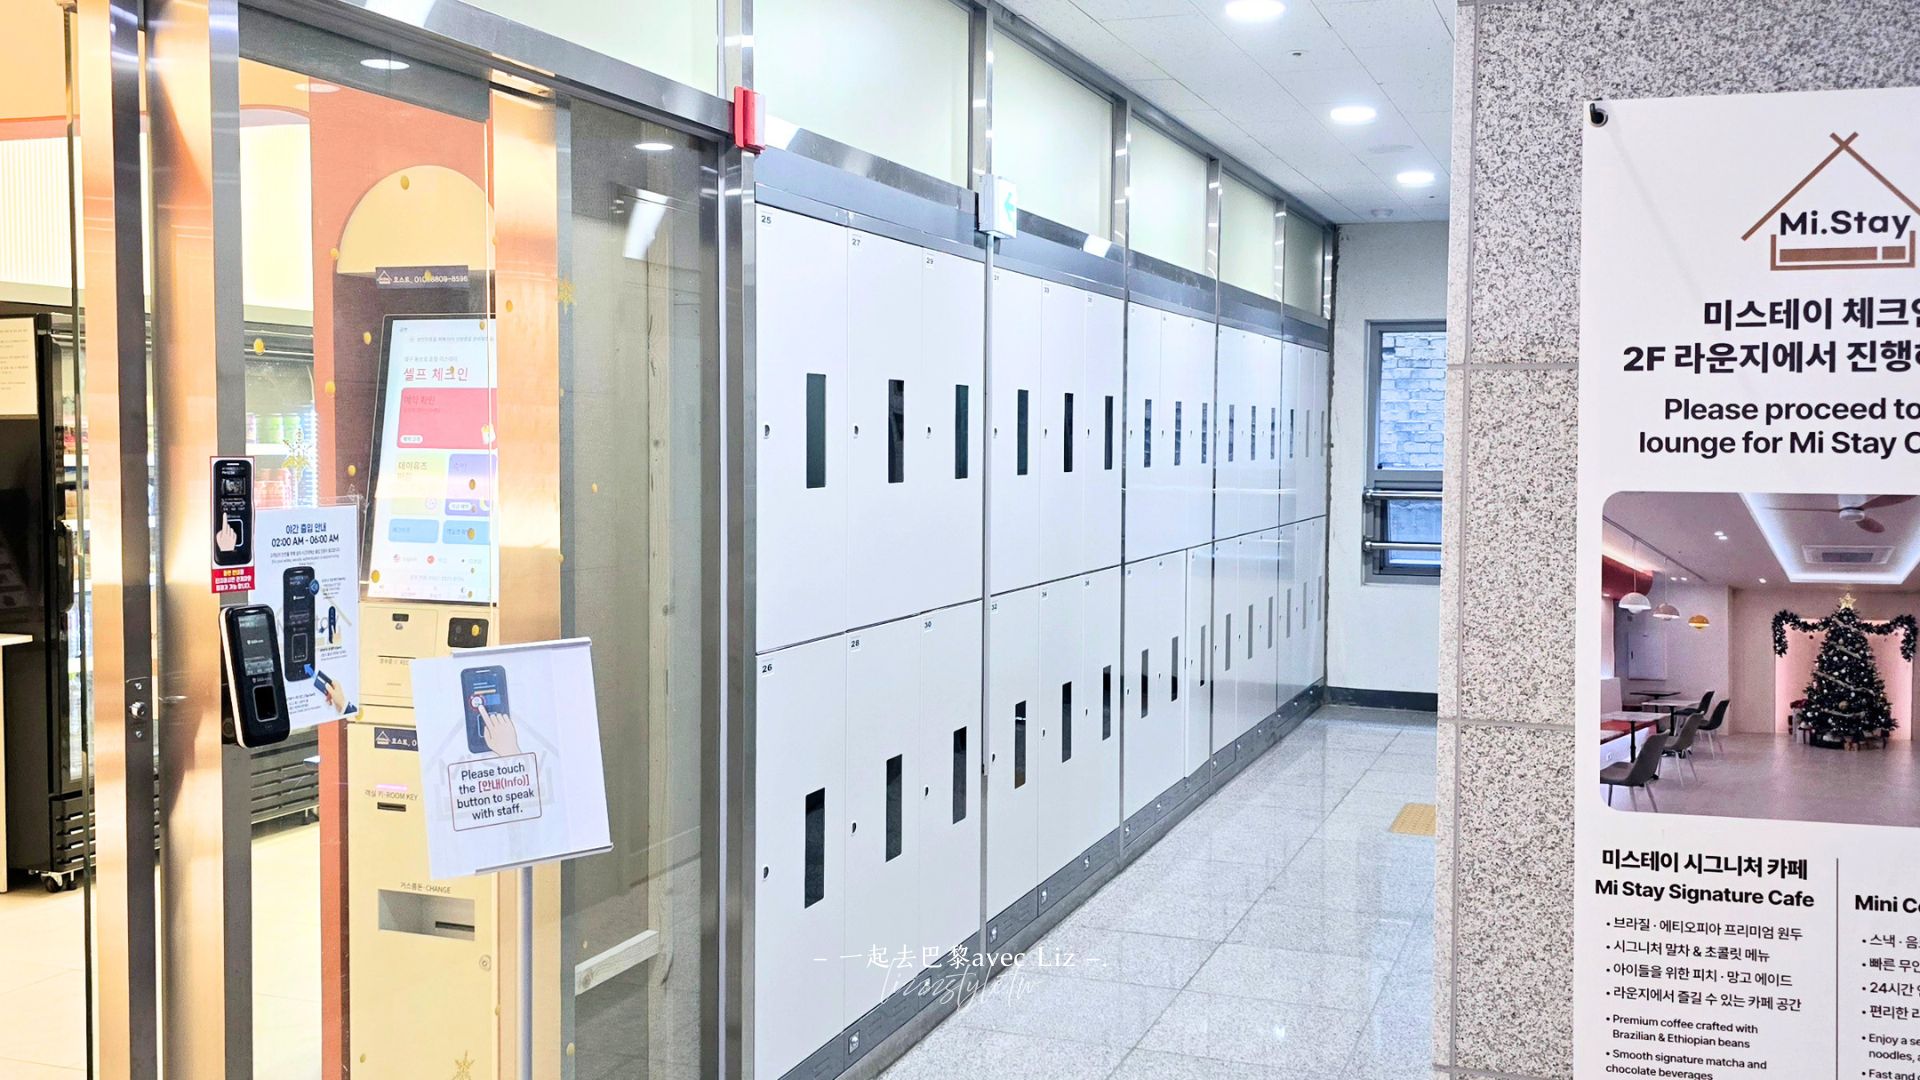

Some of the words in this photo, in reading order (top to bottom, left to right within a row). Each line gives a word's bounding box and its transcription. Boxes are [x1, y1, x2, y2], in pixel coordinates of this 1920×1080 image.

[761, 215, 772, 225] 25
[1780, 210, 1911, 239] Mi.Stay
[1704, 298, 1832, 331] 미스테이
[1623, 346, 1666, 371] 2F
[1674, 341, 1836, 374] 라운지에서
[1847, 340, 1920, 373] 진행
[1665, 398, 1758, 420] Please
[1766, 398, 1886, 425] proceed
[1894, 400, 1920, 420] to
[1640, 431, 1736, 459] lounge
[1742, 431, 1783, 453] for
[1790, 431, 1823, 453] Mi
[1831, 431, 1897, 459] Stay
[271, 537, 292, 547] 02:00
[292, 536, 304, 545] AM
[328, 534, 339, 543] AM
[851, 640, 860, 648] 28
[762, 664, 773, 673] 26
[461, 768, 495, 780] Please
[497, 762, 525, 775] touch
[458, 784, 476, 795] the
[478, 774, 530, 793] [안내(Info)]
[456, 796, 490, 809] button
[492, 794, 503, 803] to
[505, 788, 535, 803] speak
[472, 808, 494, 820] with
[497, 803, 523, 816] staff.
[1602, 849, 1679, 872] 미스테이
[1684, 853, 1762, 878] 시그니처
[1767, 858, 1808, 880] 카페
[1595, 879, 1618, 895] Mi
[1622, 881, 1665, 901] Stay
[1669, 884, 1764, 904] Signature
[1768, 890, 1814, 907] Cafe
[1855, 895, 1898, 912] Mini
[1902, 898, 1920, 913] C
[1613, 917, 1651, 931] 브라질
[1659, 919, 1721, 936] 에티오피아
[1724, 924, 1774, 939] 프리미엄
[1777, 927, 1803, 941] 원두
[1613, 939, 1662, 955] 시그니처
[1665, 943, 1690, 957] 말차
[1693, 946, 1702, 956] &
[1705, 946, 1742, 961] 초콜릿
[1745, 948, 1770, 963] 메뉴
[1870, 934, 1896, 948] 스낵
[1905, 936, 1920, 949] 음
[1869, 957, 1896, 972] 빠른
[1613, 963, 1662, 979] 아이들을
[1665, 966, 1690, 980] 위한
[1693, 968, 1718, 982] 피치
[1727, 971, 1752, 984] 망고
[1755, 973, 1793, 987] 에이드
[1613, 986, 1674, 1003] 라운지에서
[1677, 990, 1702, 1004] 즐길
[1705, 993, 1718, 1006] 수
[1720, 993, 1746, 1008] 있는
[1748, 996, 1774, 1010] 카페
[1776, 998, 1802, 1012] 공간
[1870, 982, 1914, 997] 24시간
[1870, 1005, 1909, 1020] 편리한
[1612, 1014, 1659, 1027] Premium
[1660, 1018, 1694, 1029] coffee
[1695, 1021, 1733, 1032] crafted
[1735, 1023, 1758, 1034] with
[1612, 1029, 1656, 1042] Brazilian
[1658, 1033, 1666, 1042] &
[1667, 1034, 1716, 1046] Ethiopian
[1718, 1038, 1750, 1048] beans
[1868, 1033, 1899, 1046] Enjoy
[1901, 1037, 1908, 1045] a
[1612, 1049, 1653, 1061] Smooth
[1655, 1052, 1704, 1065] signature
[1705, 1057, 1745, 1068] matcha
[1747, 1061, 1767, 1069] and
[1868, 1050, 1915, 1063] noodles,
[1605, 1064, 1656, 1076] chocolate
[1658, 1068, 1714, 1080] beverages
[1868, 1069, 1893, 1080] Fast
[1894, 1072, 1916, 1080] and
